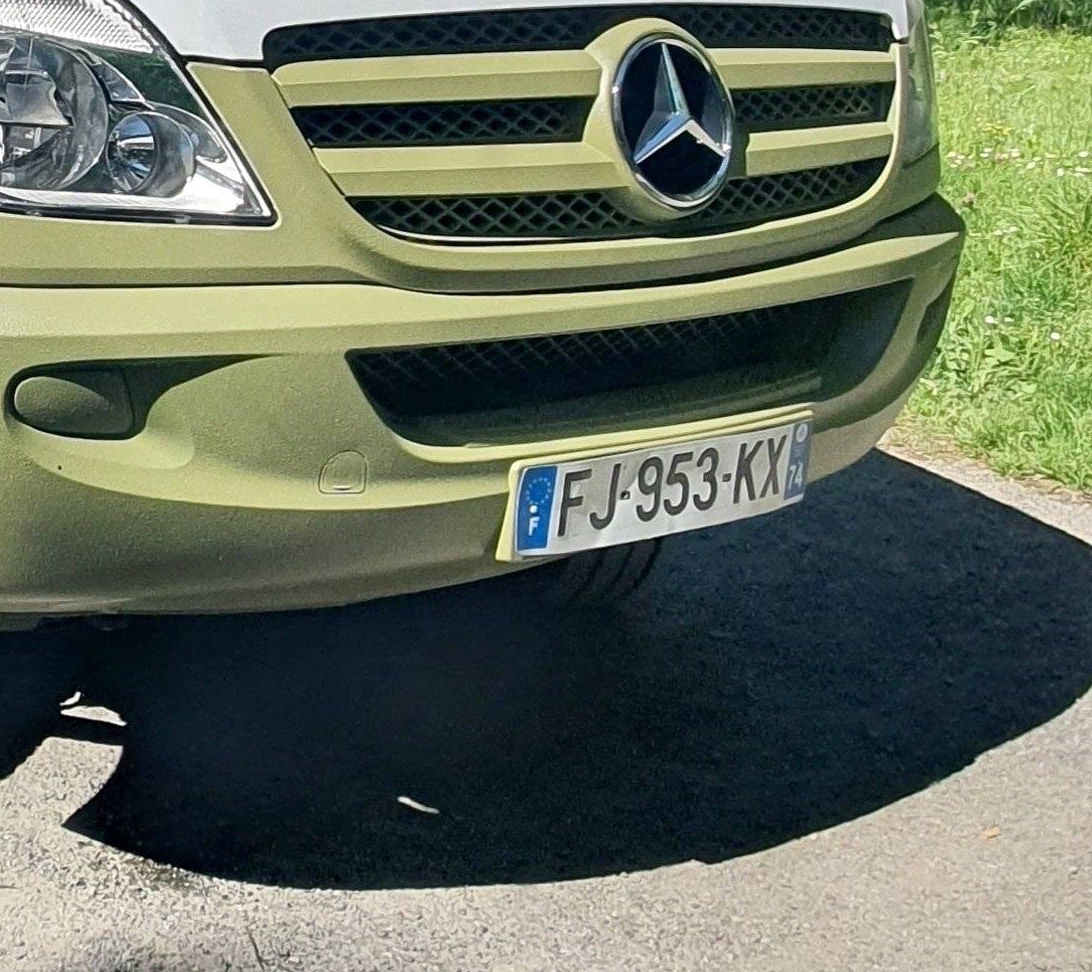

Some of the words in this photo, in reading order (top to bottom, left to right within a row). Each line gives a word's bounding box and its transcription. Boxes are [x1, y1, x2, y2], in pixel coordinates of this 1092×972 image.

[557, 435, 787, 536] FJ-953-KX
[789, 461, 804, 490] 74
[528, 516, 540, 536] F
